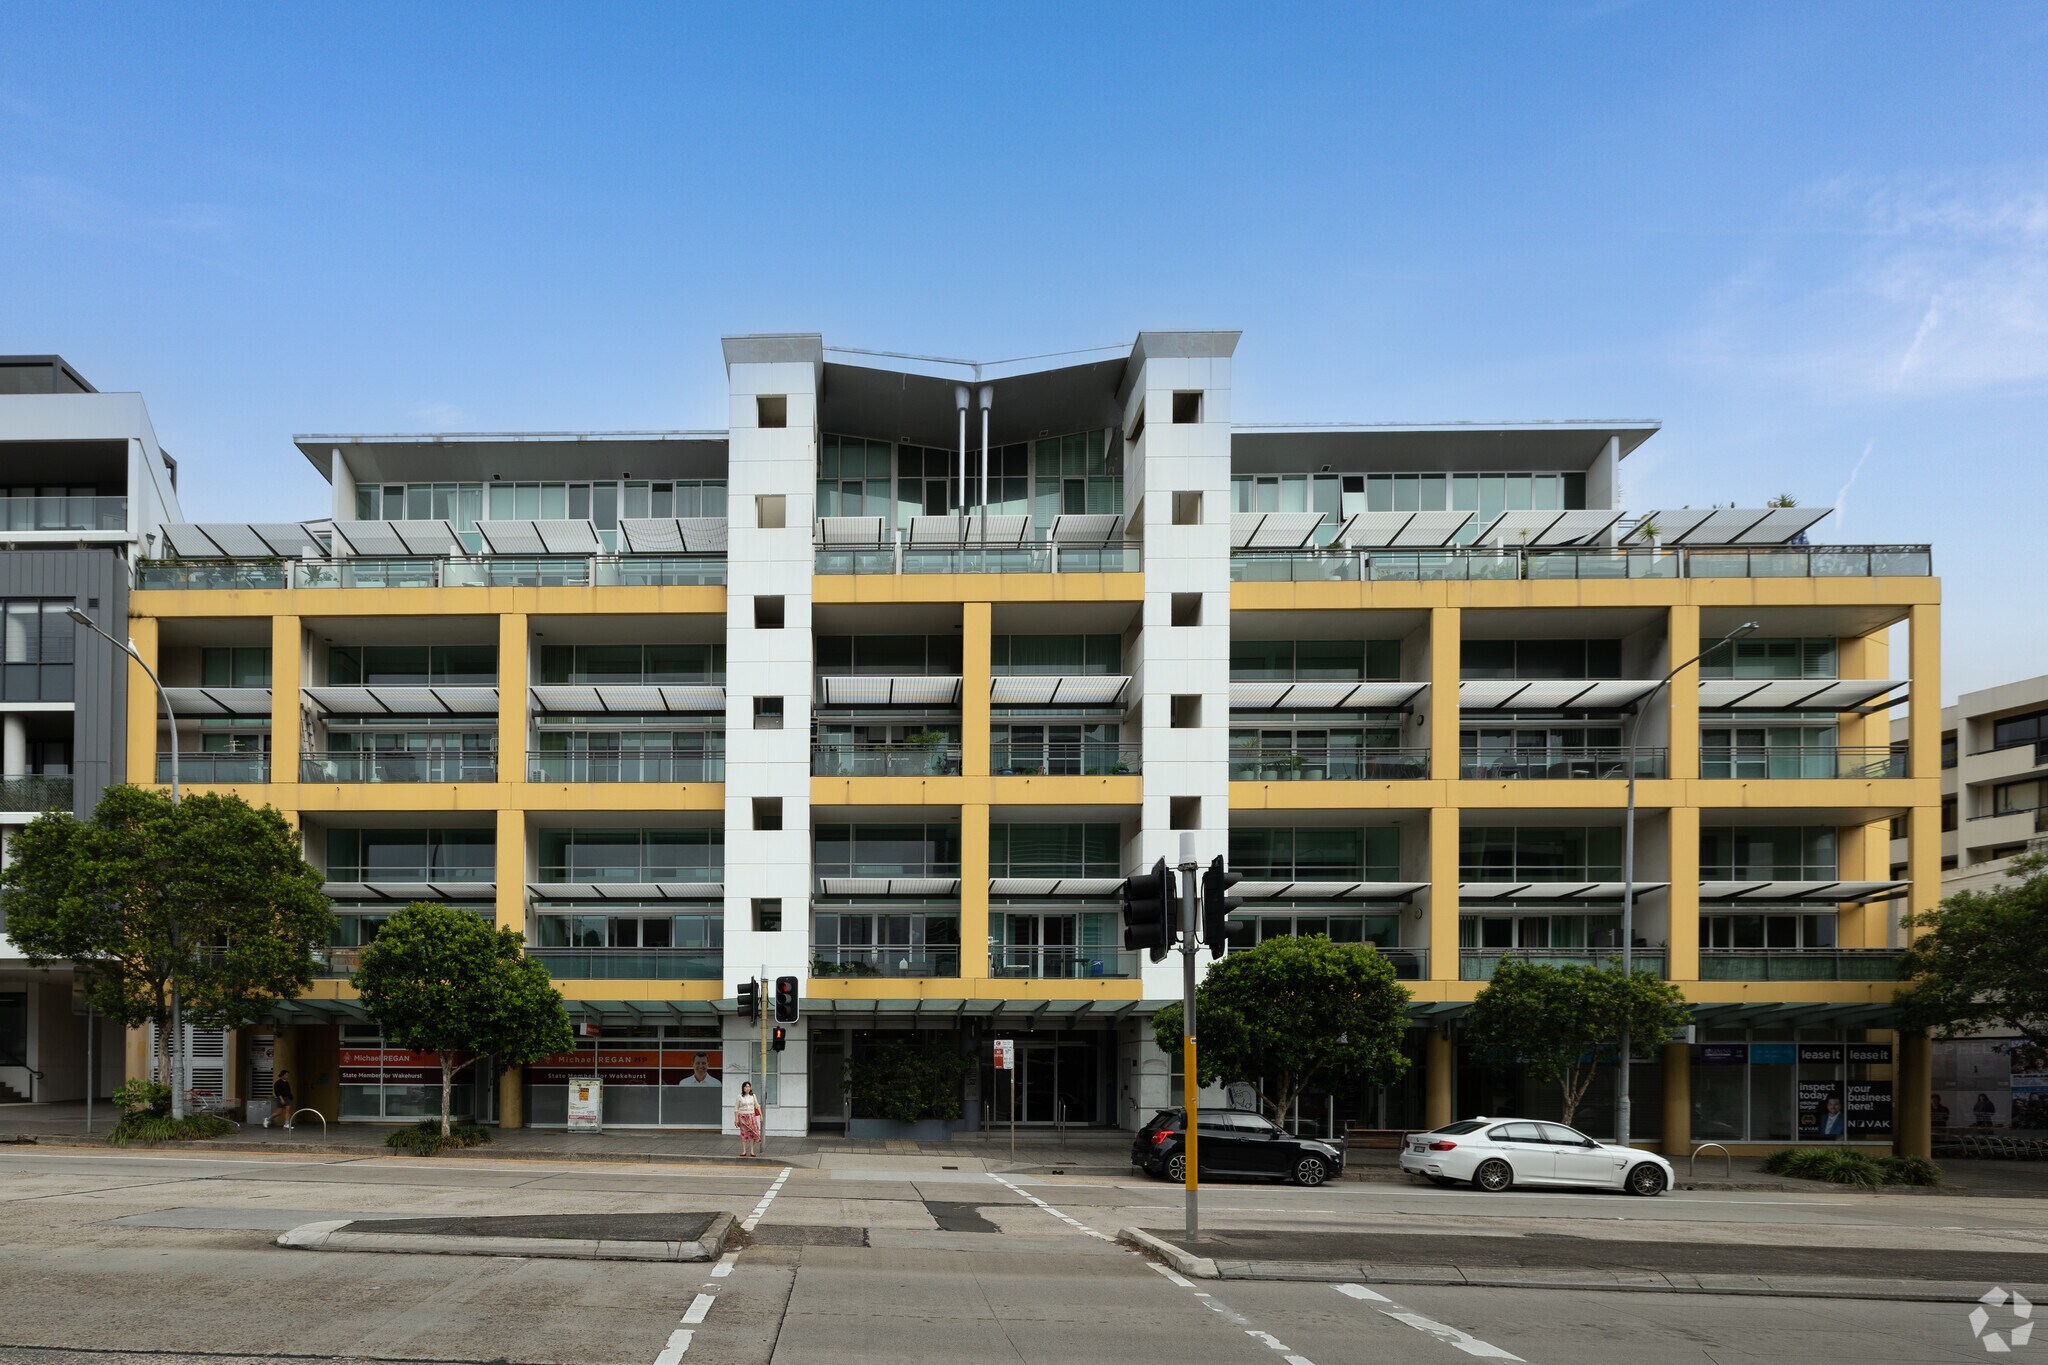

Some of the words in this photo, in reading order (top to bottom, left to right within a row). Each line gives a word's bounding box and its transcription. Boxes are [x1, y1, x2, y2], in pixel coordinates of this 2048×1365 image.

[1802, 1050, 1831, 1059] lease
[1832, 1050, 1840, 1059] it
[1850, 1050, 1879, 1059] lease
[1881, 1050, 1888, 1059] it
[1800, 1083, 1835, 1093] inspect
[1848, 1086, 1871, 1094] your
[1800, 1092, 1828, 1101] today
[1848, 1093, 1891, 1102] business
[1848, 1102, 1873, 1110] here!
